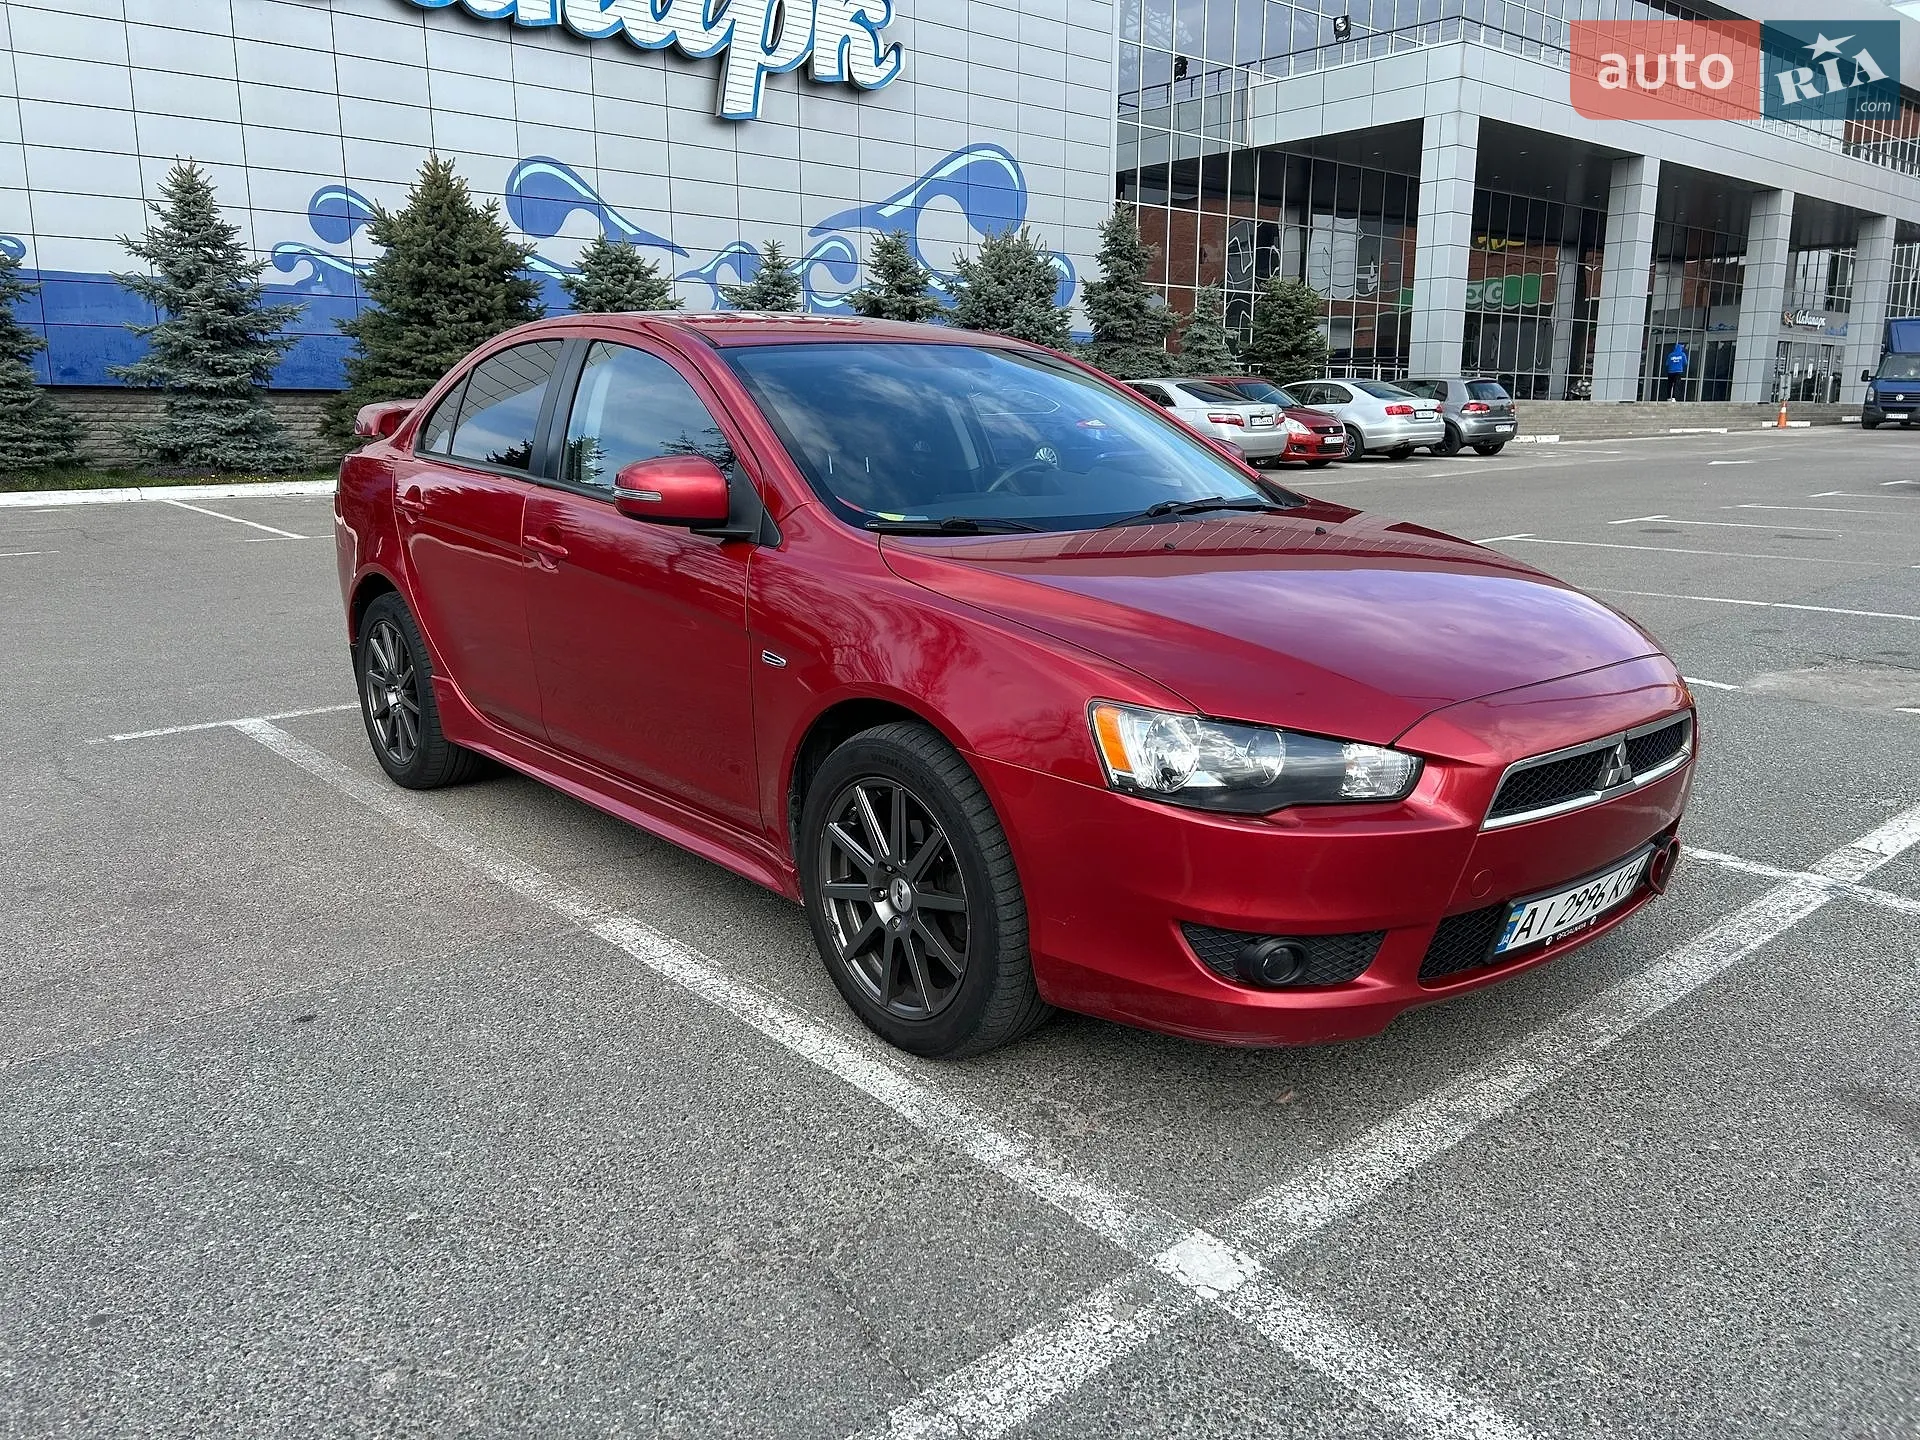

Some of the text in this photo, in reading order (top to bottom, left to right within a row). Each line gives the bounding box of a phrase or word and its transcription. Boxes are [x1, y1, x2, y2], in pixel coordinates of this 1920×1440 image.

[1511, 901, 1556, 944] AI
[1554, 876, 1614, 928] 2996
[1607, 858, 1645, 903] KH
